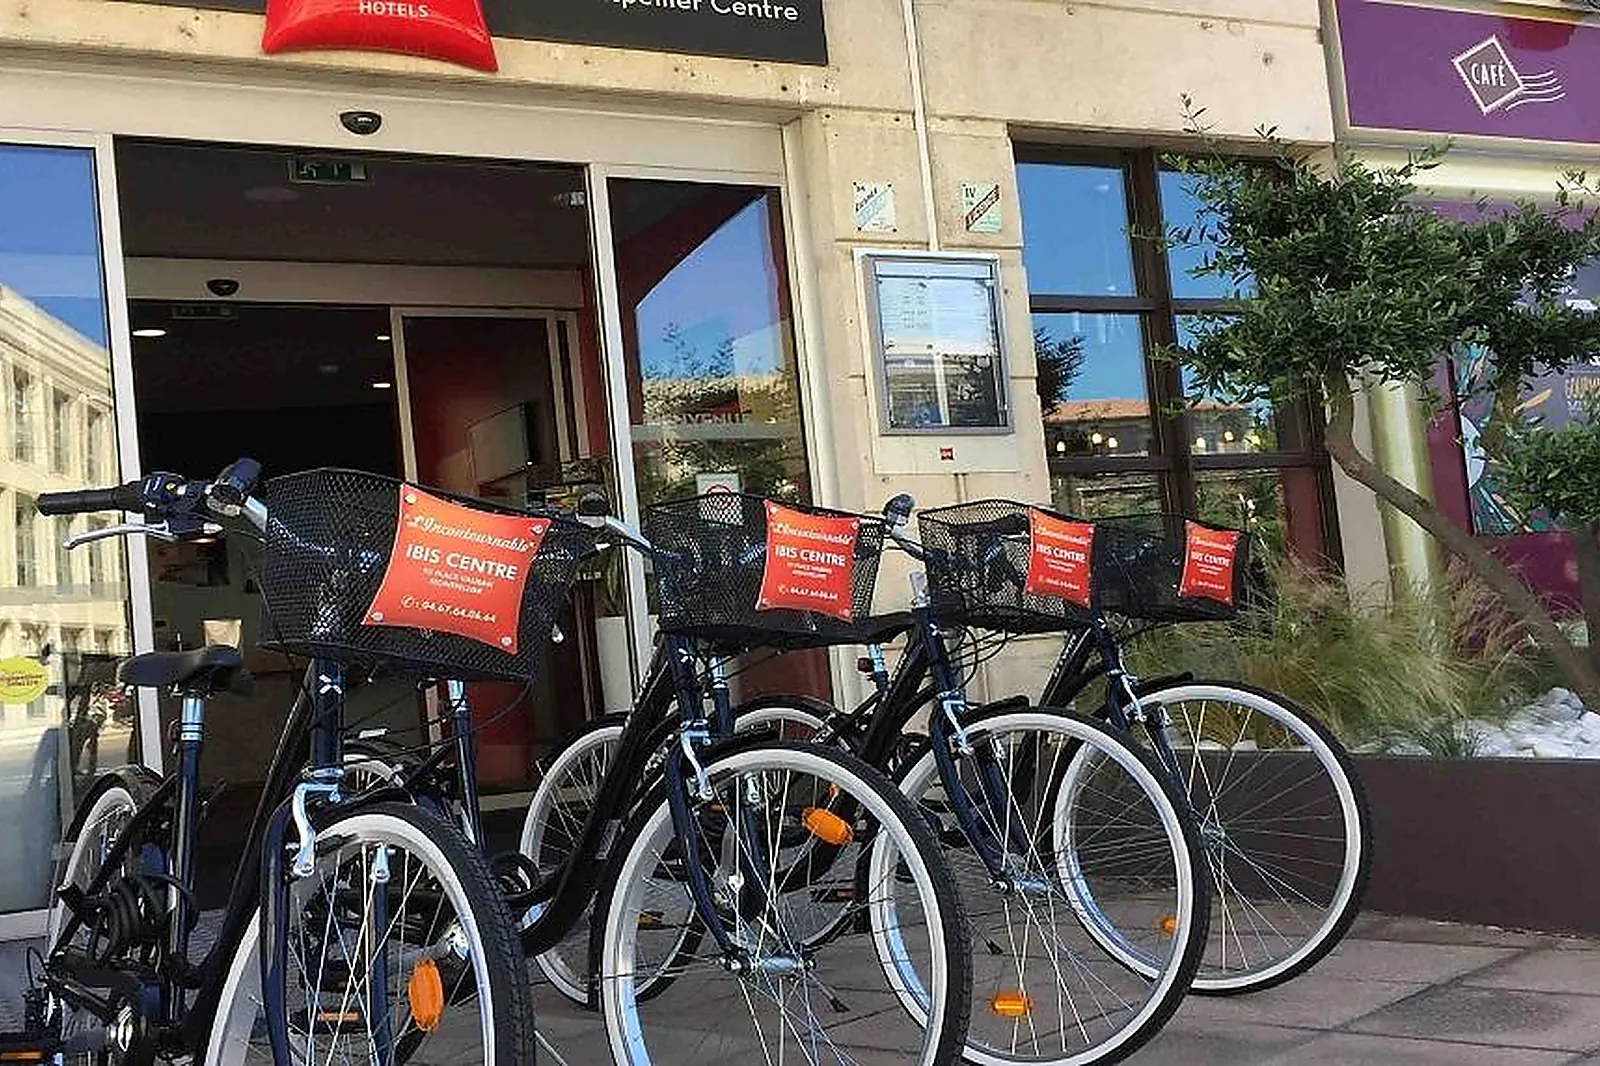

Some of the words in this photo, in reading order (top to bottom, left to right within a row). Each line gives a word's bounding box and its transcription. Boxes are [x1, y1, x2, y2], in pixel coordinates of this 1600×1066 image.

[360, 1, 429, 18] HOTELS
[710, 0, 799, 21] Centre
[1471, 60, 1507, 87] CAFÉ
[406, 543, 441, 565] IBIS
[446, 551, 519, 581] CENTRE
[775, 544, 798, 559] IBIS
[800, 548, 846, 567] CENTRE
